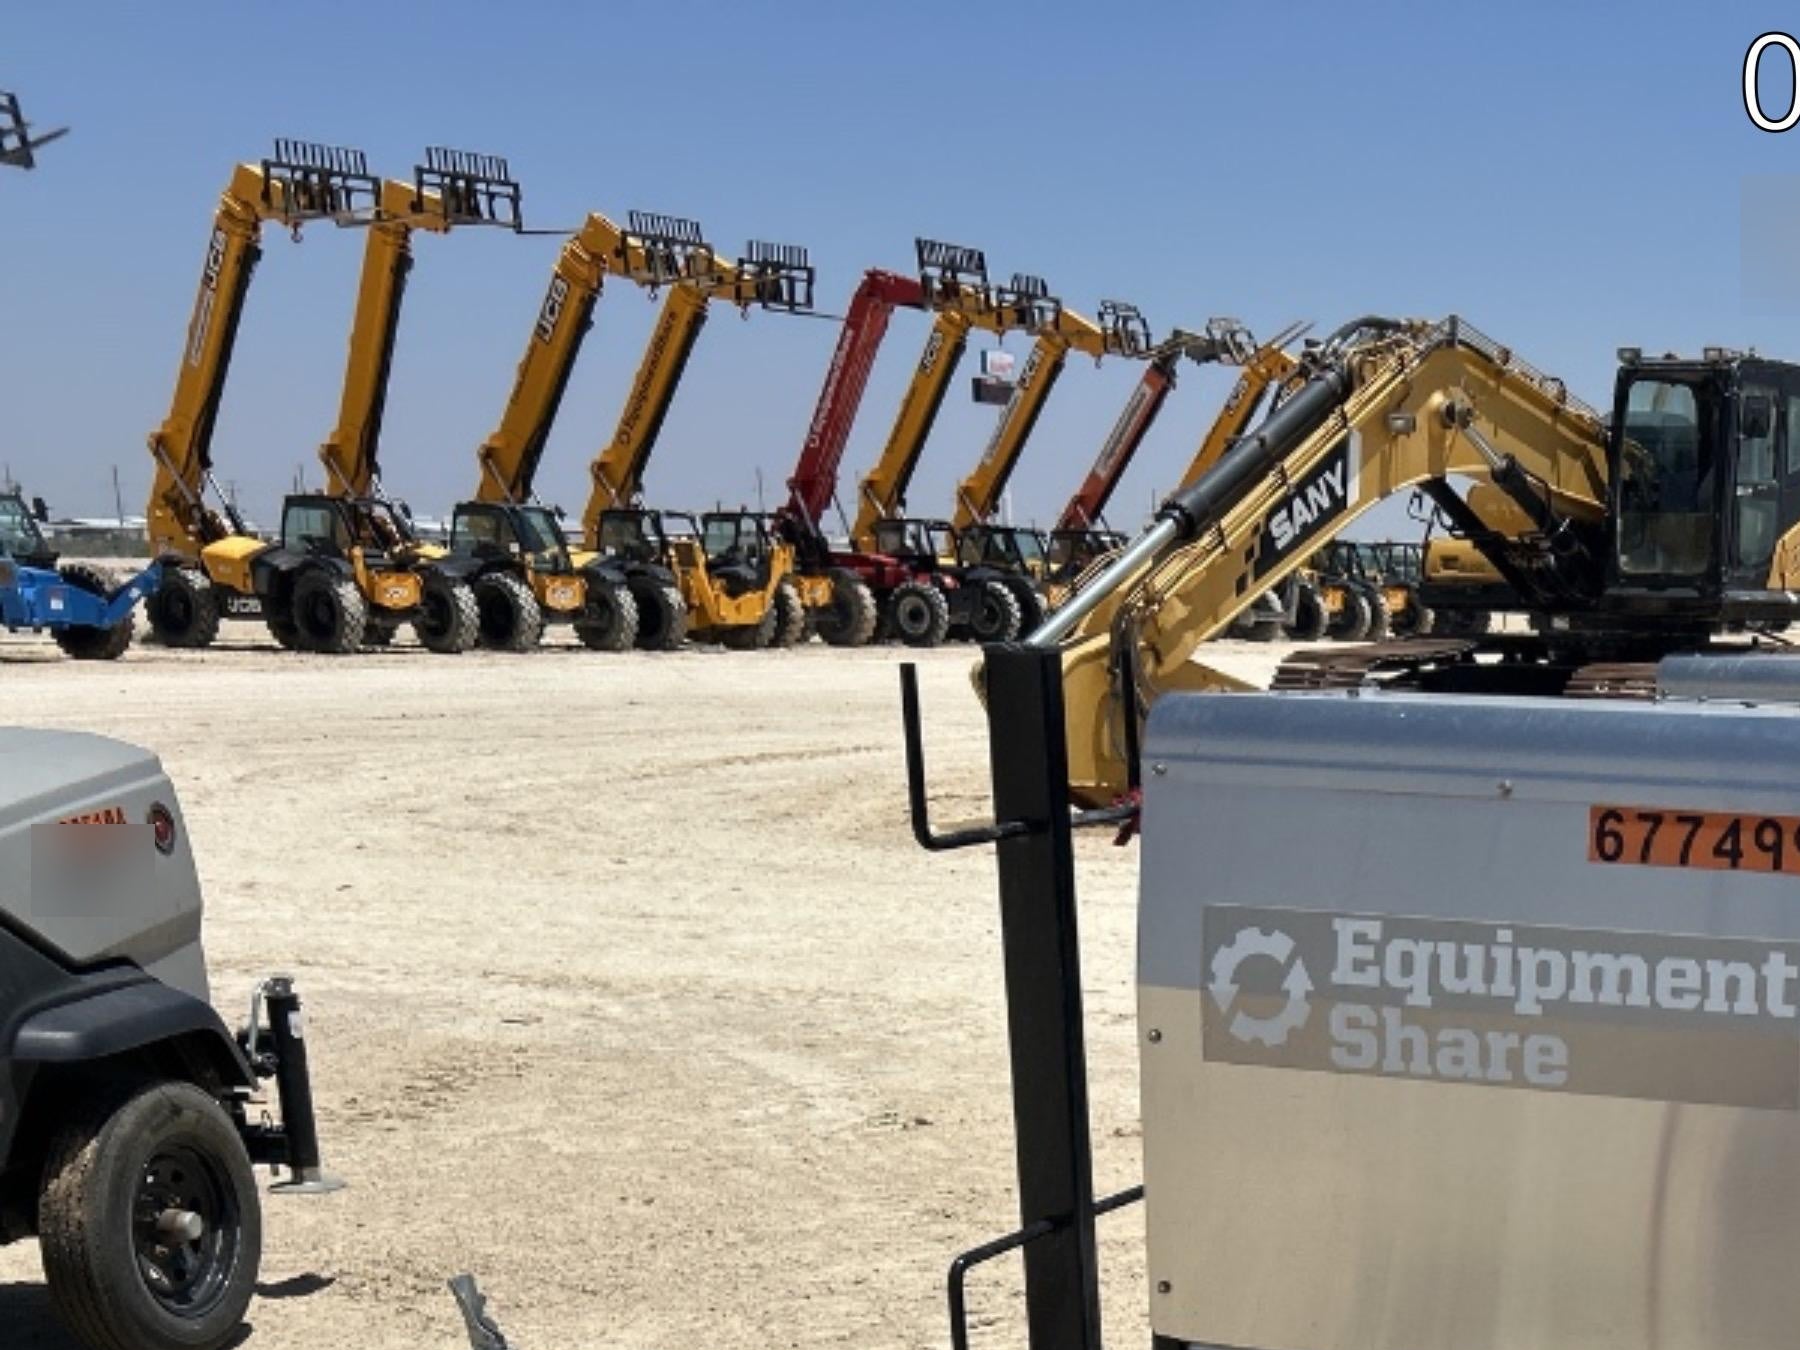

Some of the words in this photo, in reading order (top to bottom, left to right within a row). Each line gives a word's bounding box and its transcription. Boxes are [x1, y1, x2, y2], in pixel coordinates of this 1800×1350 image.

[536, 274, 569, 344] JCB
[1268, 458, 1346, 551] SANY
[1330, 917, 1799, 1019] Equipment
[1328, 1003, 1570, 1085] Share
